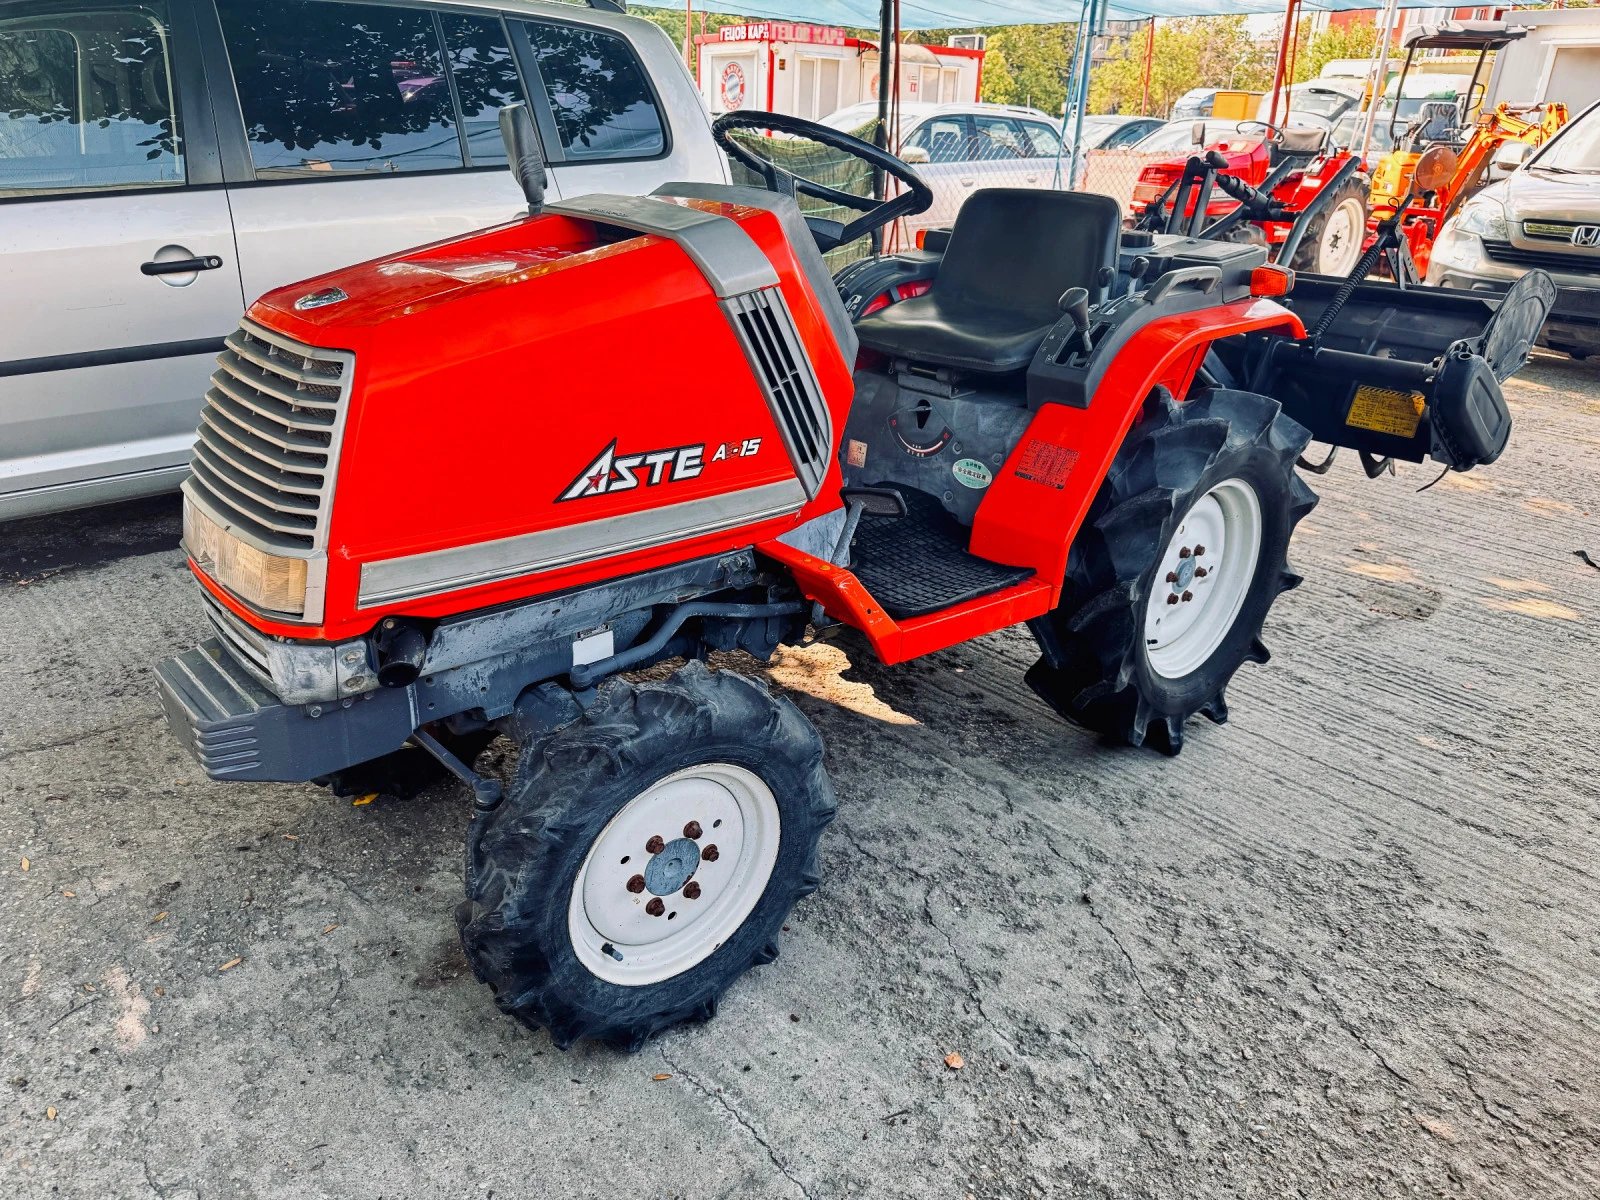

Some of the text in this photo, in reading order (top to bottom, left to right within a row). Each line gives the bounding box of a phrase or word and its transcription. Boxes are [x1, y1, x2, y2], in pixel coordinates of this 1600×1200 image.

[720, 26, 746, 41] ГЕЦОВ
[748, 24, 764, 39] КАР
[553, 437, 763, 503] ASTE A-15
